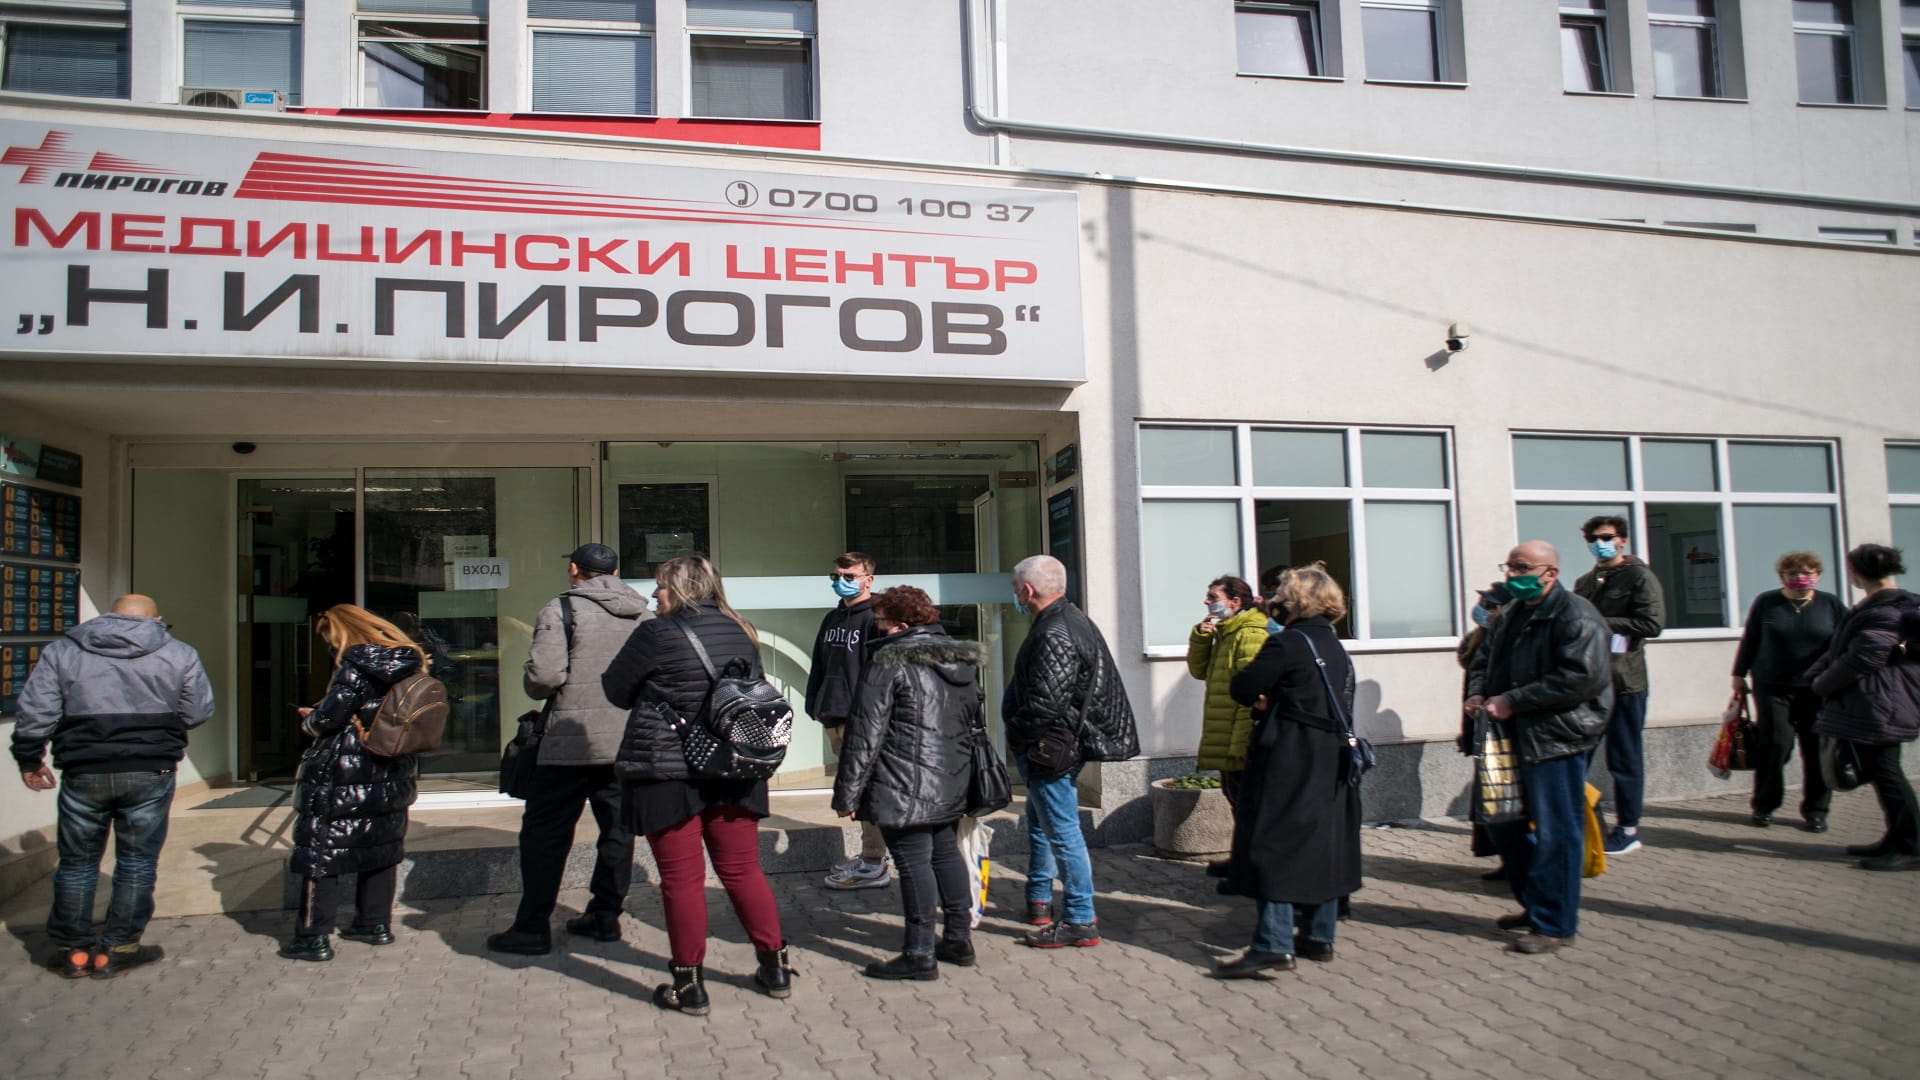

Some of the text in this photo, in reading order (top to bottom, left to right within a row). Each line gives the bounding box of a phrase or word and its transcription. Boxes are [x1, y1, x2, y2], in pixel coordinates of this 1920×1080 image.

[54, 172, 229, 197] ПИРОГОВ
[769, 188, 1036, 223] 0700 100 37
[15, 207, 1039, 292] МЕДИЦИНСКИ ЦЕНТЪР
[463, 564, 502, 577] ВХОД
